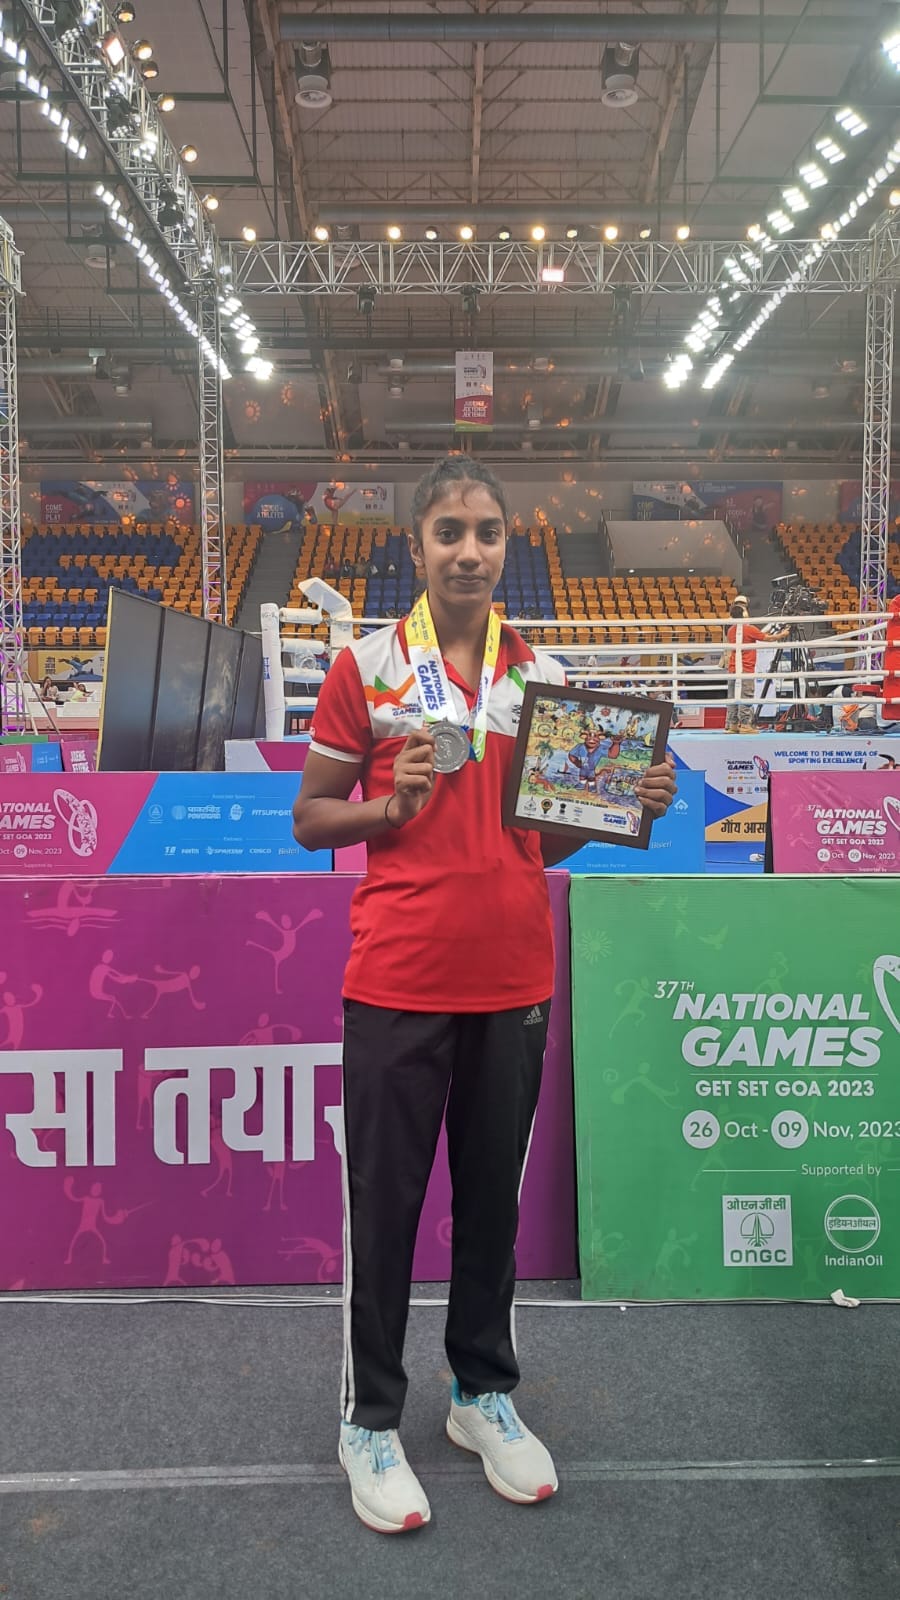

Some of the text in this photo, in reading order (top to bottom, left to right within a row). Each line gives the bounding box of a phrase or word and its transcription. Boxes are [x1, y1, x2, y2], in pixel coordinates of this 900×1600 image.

[417, 664, 439, 711] GAMES
[428, 660, 447, 707] NATIONAL
[393, 708, 422, 716] GAMES
[0, 803, 51, 813] TIONAL
[813, 809, 882, 819] NATIONAL
[0, 815, 56, 829] AMES
[602, 817, 628, 825] GAMES
[744, 822, 766, 833] आस
[816, 820, 887, 835] GAMES
[878, 852, 895, 860] 2023
[654, 981, 694, 999] 37TH
[672, 993, 870, 1020] NATIONAL
[523, 1015, 544, 1026] adidas
[681, 1026, 883, 1067] GAMES
[695, 1080, 875, 1097] GET SET GOA 2023
[690, 1121, 713, 1138] 26
[724, 1121, 758, 1138] Oct
[778, 1121, 802, 1138] 09
[813, 1121, 854, 1141] Nov,
[801, 1163, 882, 1177] Supported by
[825, 1255, 883, 1266] IndianOil
